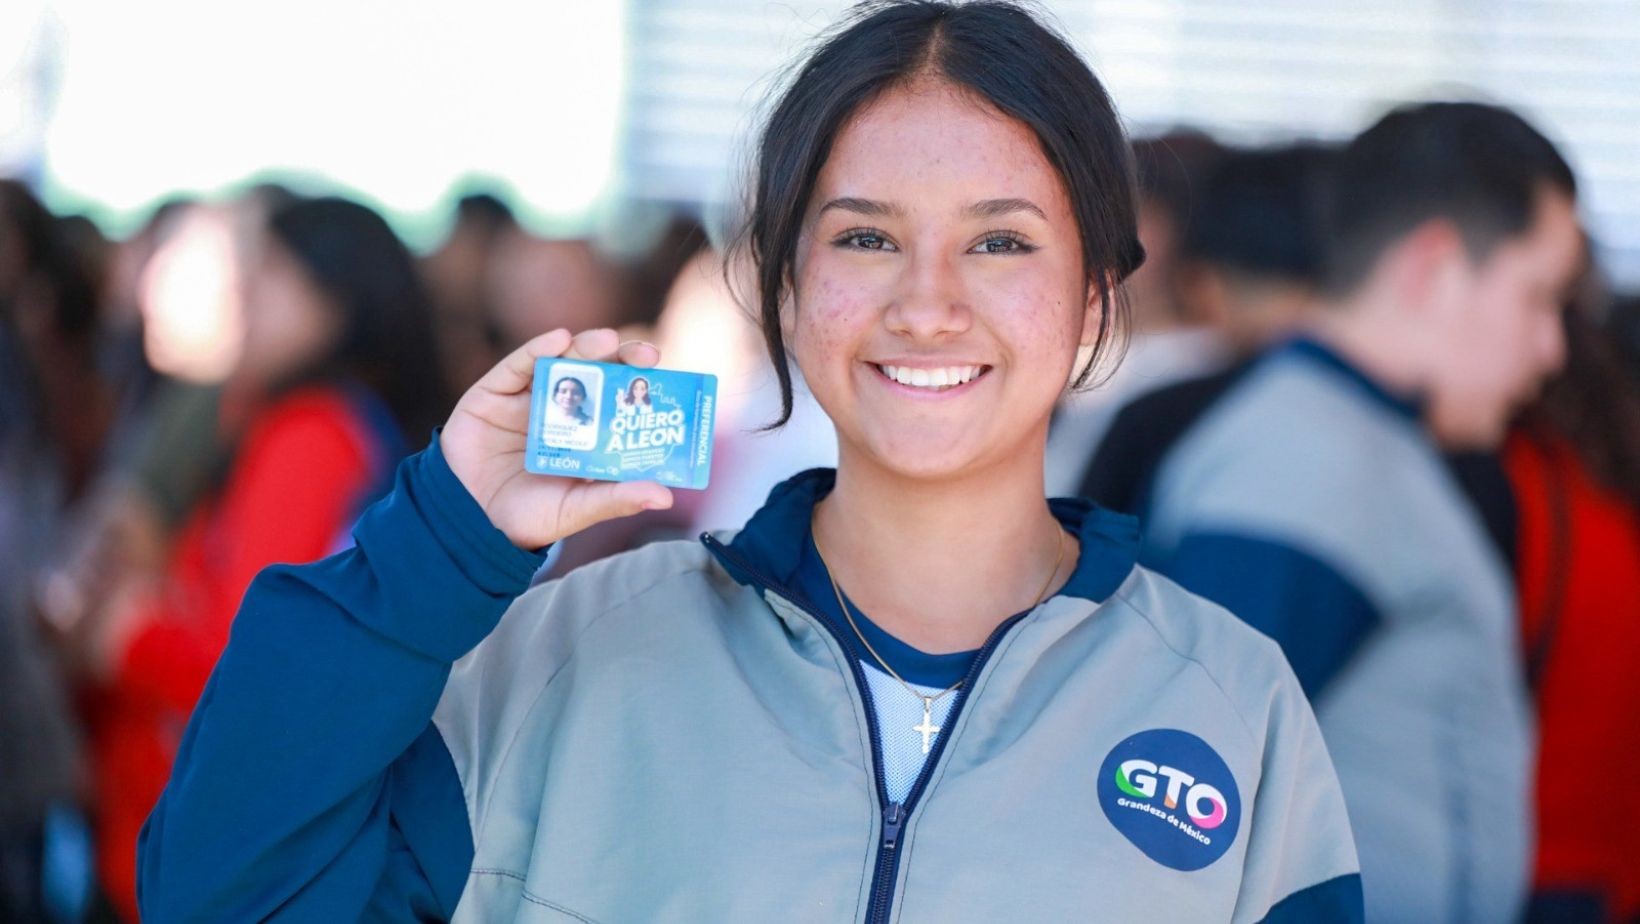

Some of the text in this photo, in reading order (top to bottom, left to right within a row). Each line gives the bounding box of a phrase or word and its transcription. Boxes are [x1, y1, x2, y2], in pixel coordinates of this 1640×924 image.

[610, 409, 685, 435] QUIERO
[697, 395, 712, 466] PREFERENCIAL
[604, 434, 623, 453] A
[549, 456, 580, 469] LEÓN
[1115, 759, 1228, 829] GTO
[1117, 798, 1211, 845] Grandeza de México
